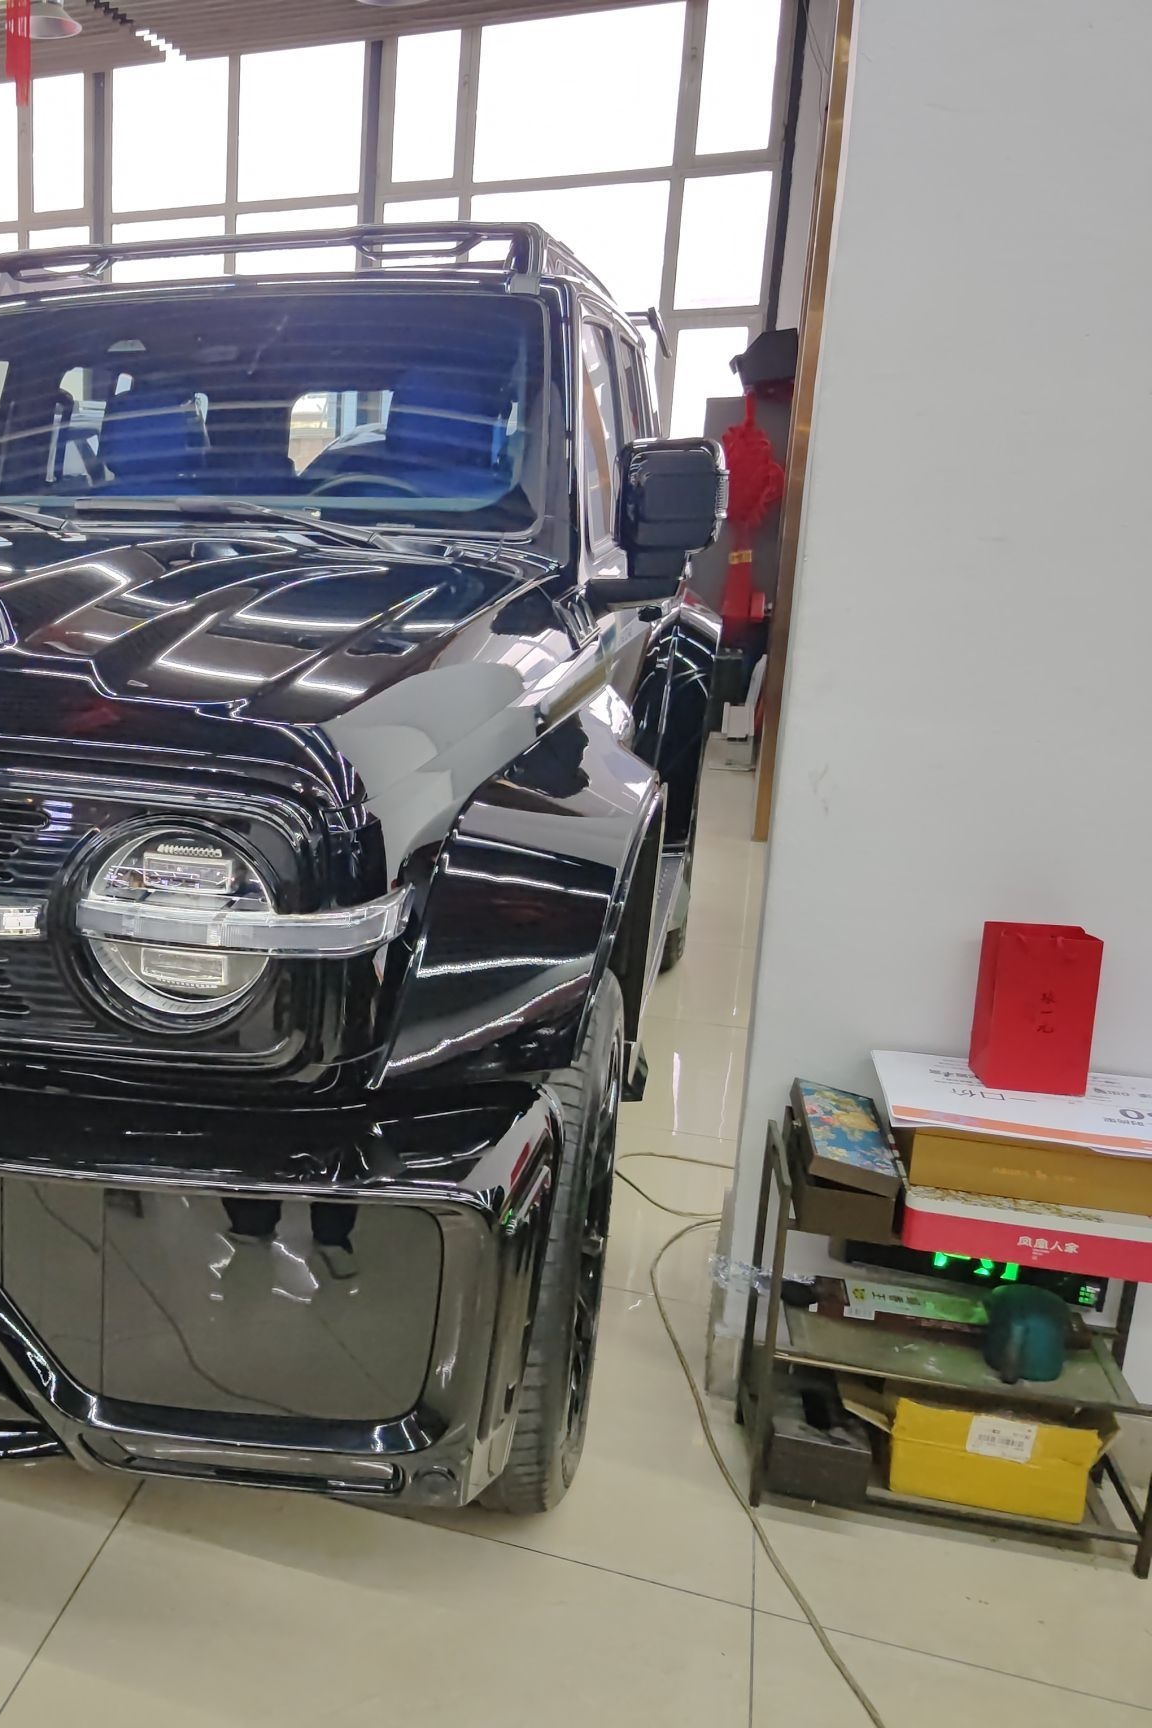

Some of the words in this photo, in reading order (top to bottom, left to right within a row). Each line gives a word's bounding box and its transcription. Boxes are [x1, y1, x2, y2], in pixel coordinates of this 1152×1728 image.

[952, 1087, 1037, 1103] 一口价
[1017, 1236, 1080, 1254] 凤凰人家
